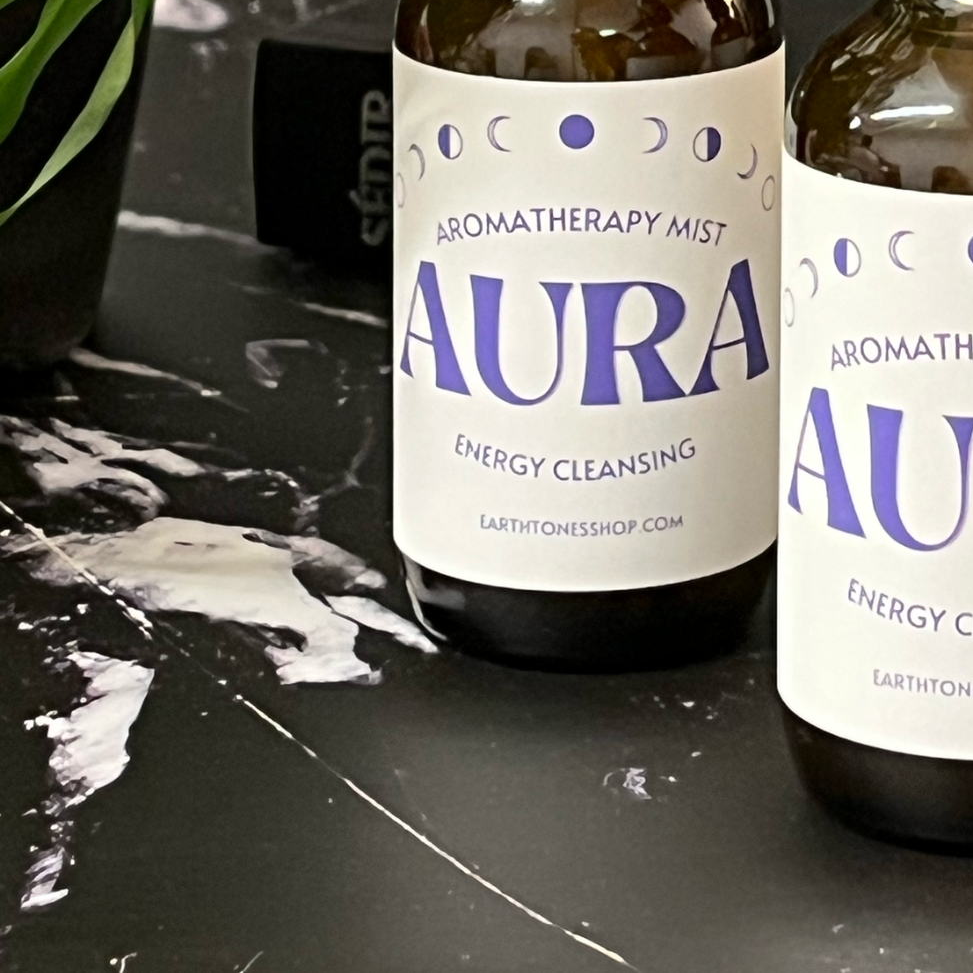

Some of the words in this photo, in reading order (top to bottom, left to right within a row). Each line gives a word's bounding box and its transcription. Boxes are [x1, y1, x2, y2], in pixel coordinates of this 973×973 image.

[437, 207, 662, 245] AROMATHERAPY
[666, 215, 727, 247] MIST
[400, 258, 770, 406] AURA
[455, 433, 546, 480] ENERGY
[553, 437, 697, 482] CLEANSING
[480, 513, 684, 538] EARTHTONESSHOP.COM
[847, 578, 947, 633] ENERGY
